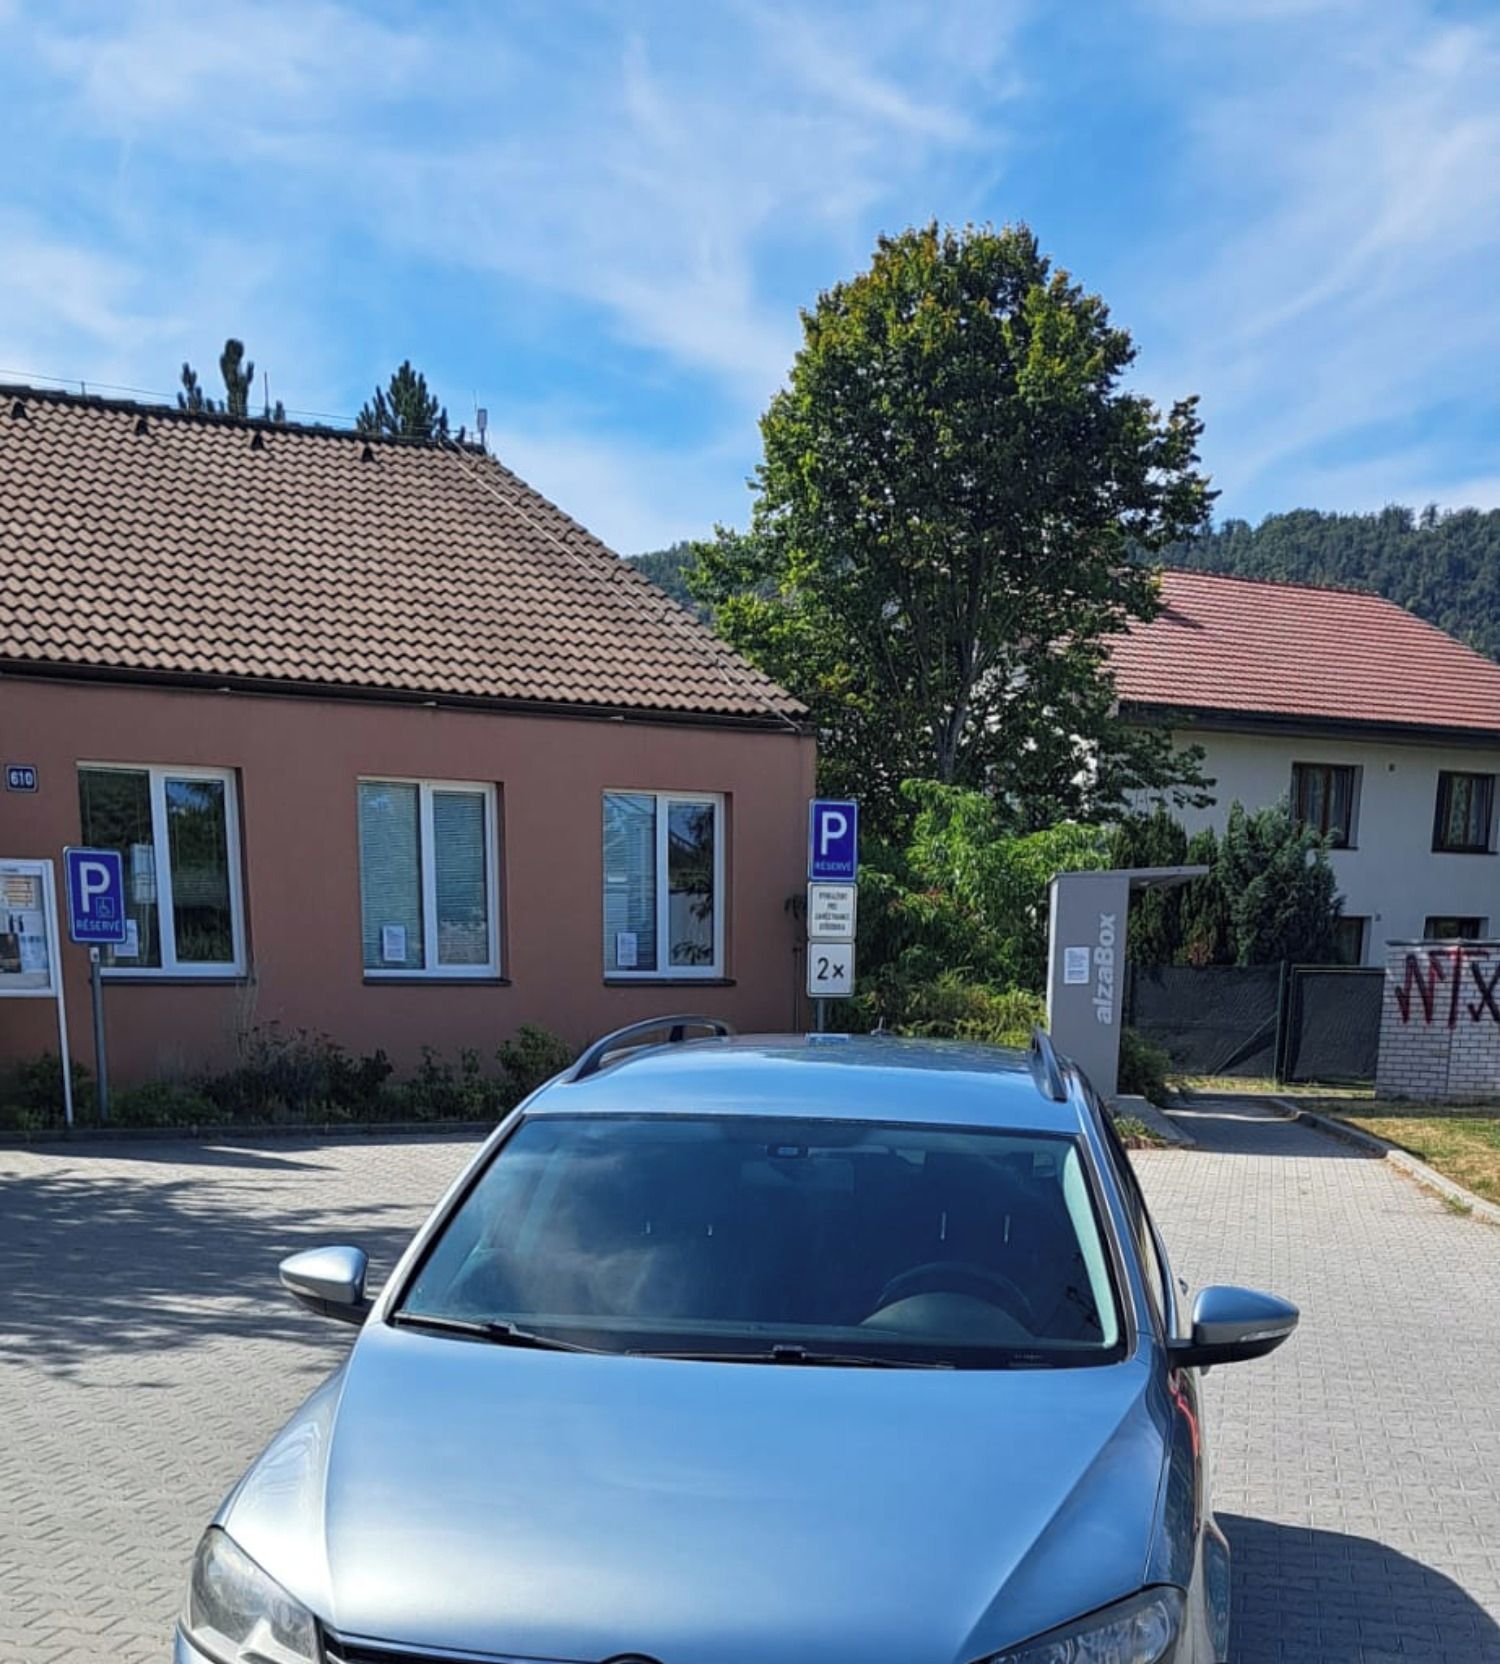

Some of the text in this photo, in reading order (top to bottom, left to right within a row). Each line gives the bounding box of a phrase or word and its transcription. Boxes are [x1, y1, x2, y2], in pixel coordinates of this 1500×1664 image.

[10, 771, 33, 786] 610
[821, 811, 848, 855] P
[79, 861, 111, 913] P
[1092, 913, 1116, 1025] alzaBox
